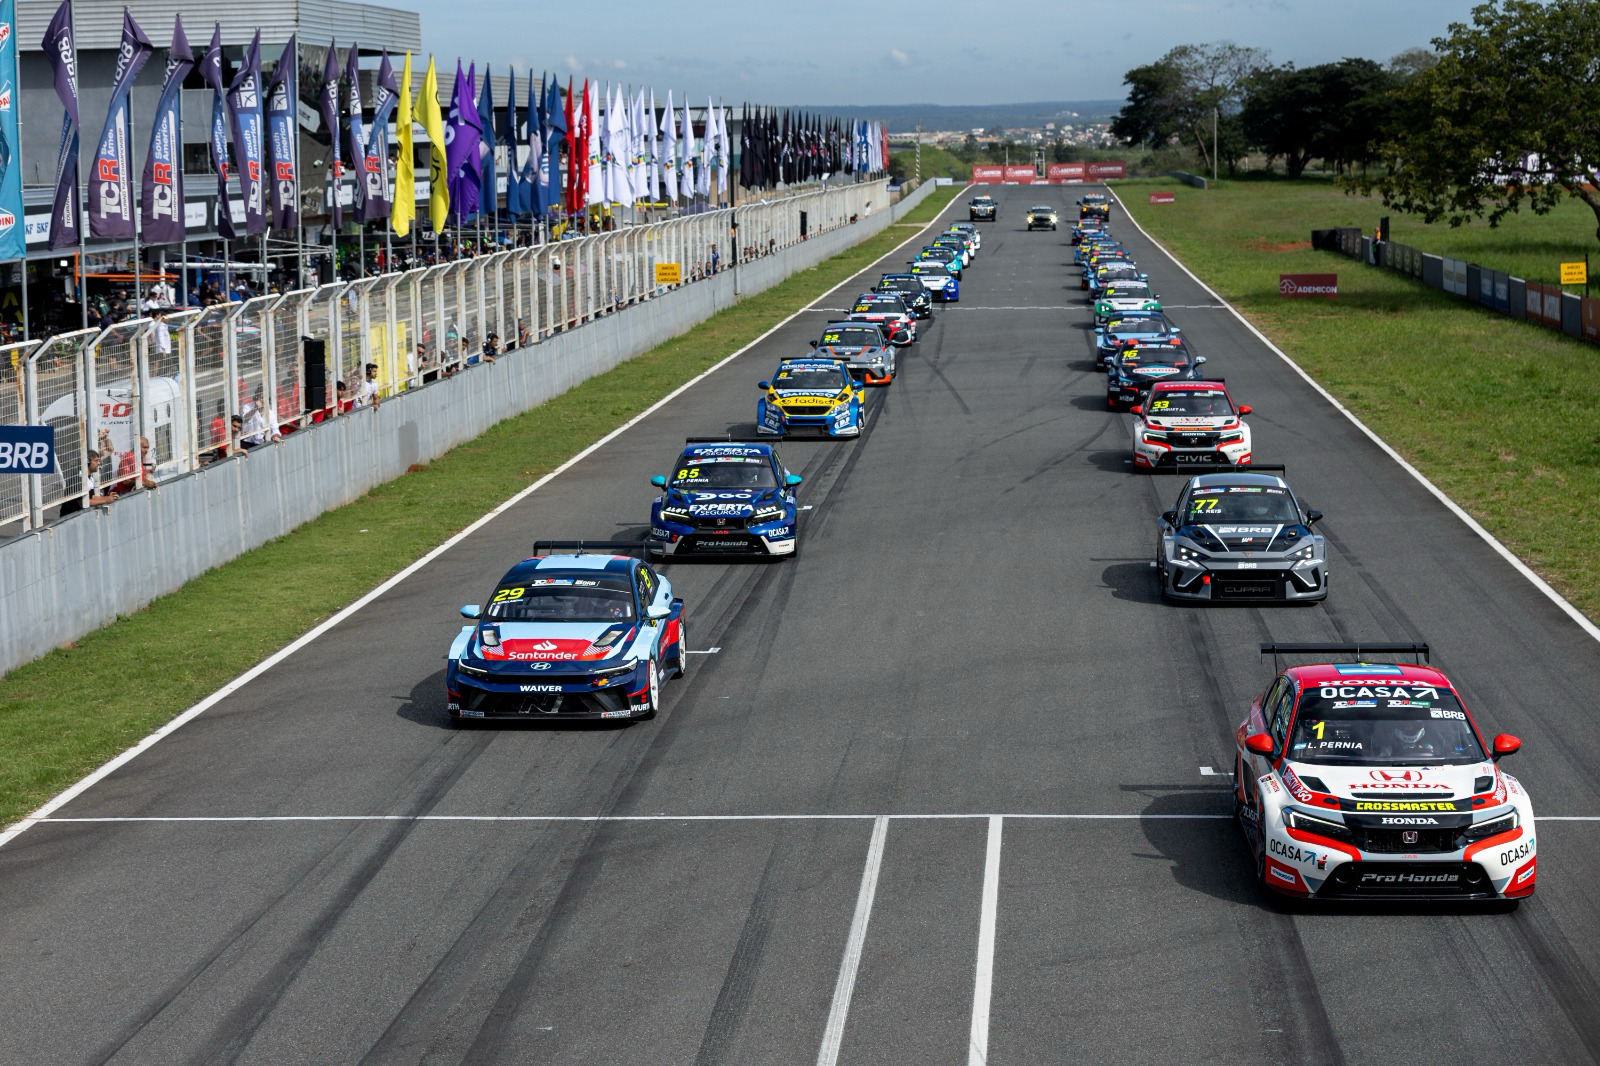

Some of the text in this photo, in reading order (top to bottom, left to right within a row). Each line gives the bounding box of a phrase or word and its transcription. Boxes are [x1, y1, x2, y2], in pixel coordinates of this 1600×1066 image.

[243, 130, 254, 159] South
[250, 119, 258, 159] America
[280, 121, 289, 160] America
[274, 132, 282, 160] South
[365, 155, 382, 200] TCR
[98, 158, 121, 219] TCR
[153, 162, 172, 220] TCR
[275, 161, 294, 211] TCR
[37, 221, 49, 234] SKF
[1297, 285, 1338, 294] ADEMICON
[1122, 349, 1138, 358] 16
[1152, 400, 1170, 409] 33
[0, 442, 49, 468] BRB
[1175, 454, 1212, 462] CIVIC
[677, 468, 700, 479] 85
[689, 503, 754, 513] EXPERTA
[1194, 498, 1219, 510] 77
[652, 527, 665, 537] OCASA
[768, 527, 785, 537] OCASA
[493, 587, 525, 602] 29
[507, 650, 578, 660] Santander
[519, 685, 563, 693] WAIVER
[1320, 687, 1411, 699] OCASA
[1443, 710, 1466, 720] BRB
[1312, 721, 1325, 740] 1
[1320, 741, 1363, 749] PERNIA
[1356, 801, 1457, 811] CROSSMASTER
[1381, 817, 1439, 825] HONDA
[1270, 838, 1302, 861] OCASA
[1501, 843, 1530, 866] OCASA
[1361, 873, 1459, 882] Pro Honda
